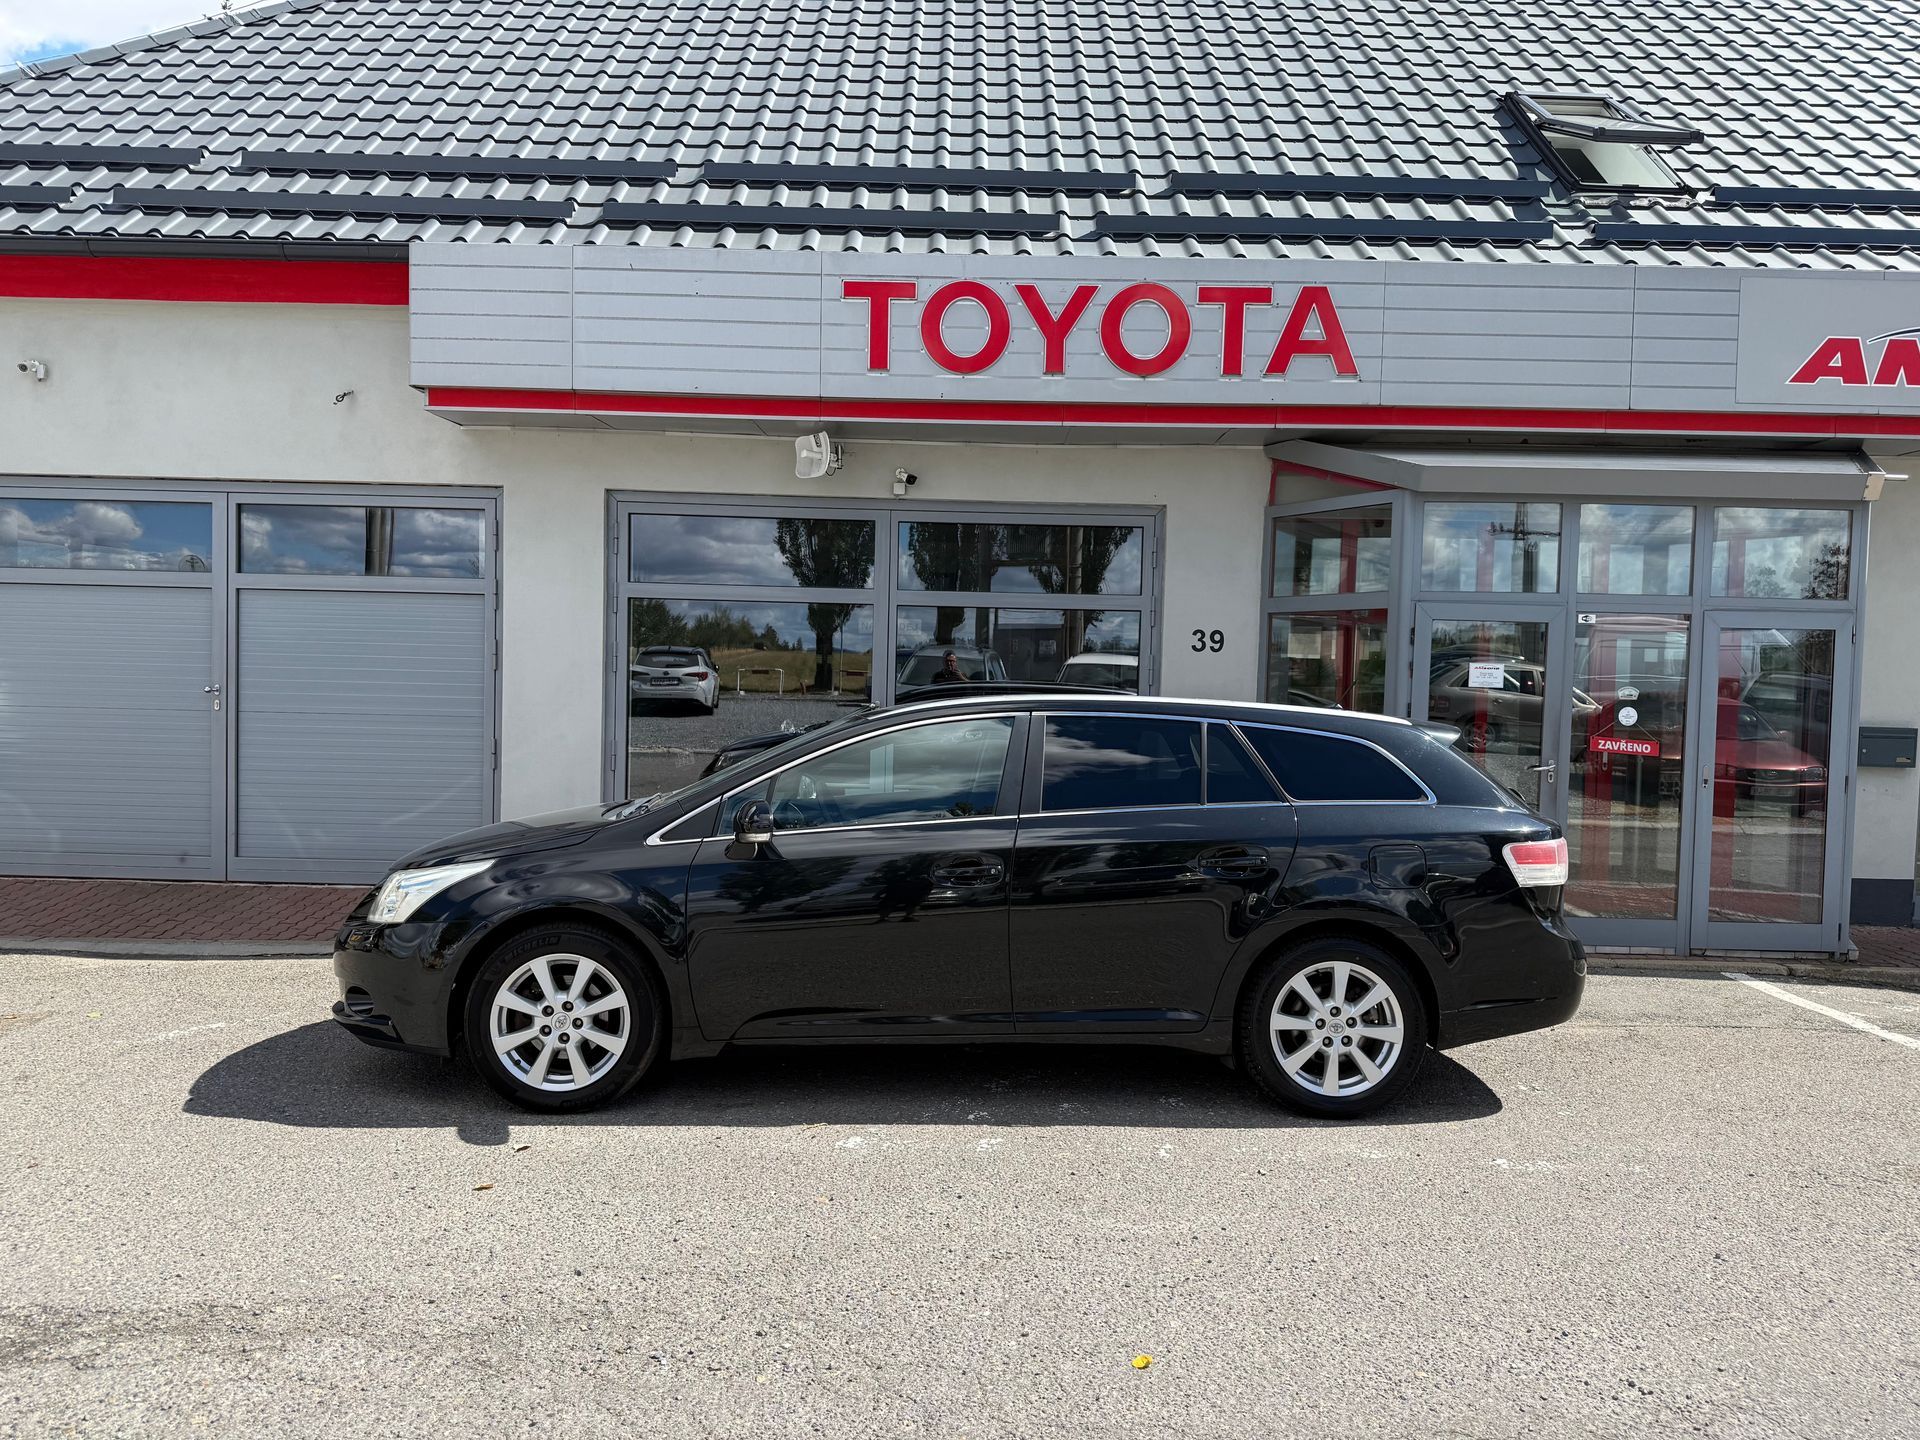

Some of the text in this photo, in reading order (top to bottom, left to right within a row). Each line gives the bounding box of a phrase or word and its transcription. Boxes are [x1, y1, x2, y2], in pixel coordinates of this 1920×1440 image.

[842, 279, 1359, 376] TOYOTA
[1191, 629, 1225, 652] 39
[1598, 740, 1651, 753] ZAVŘENO
